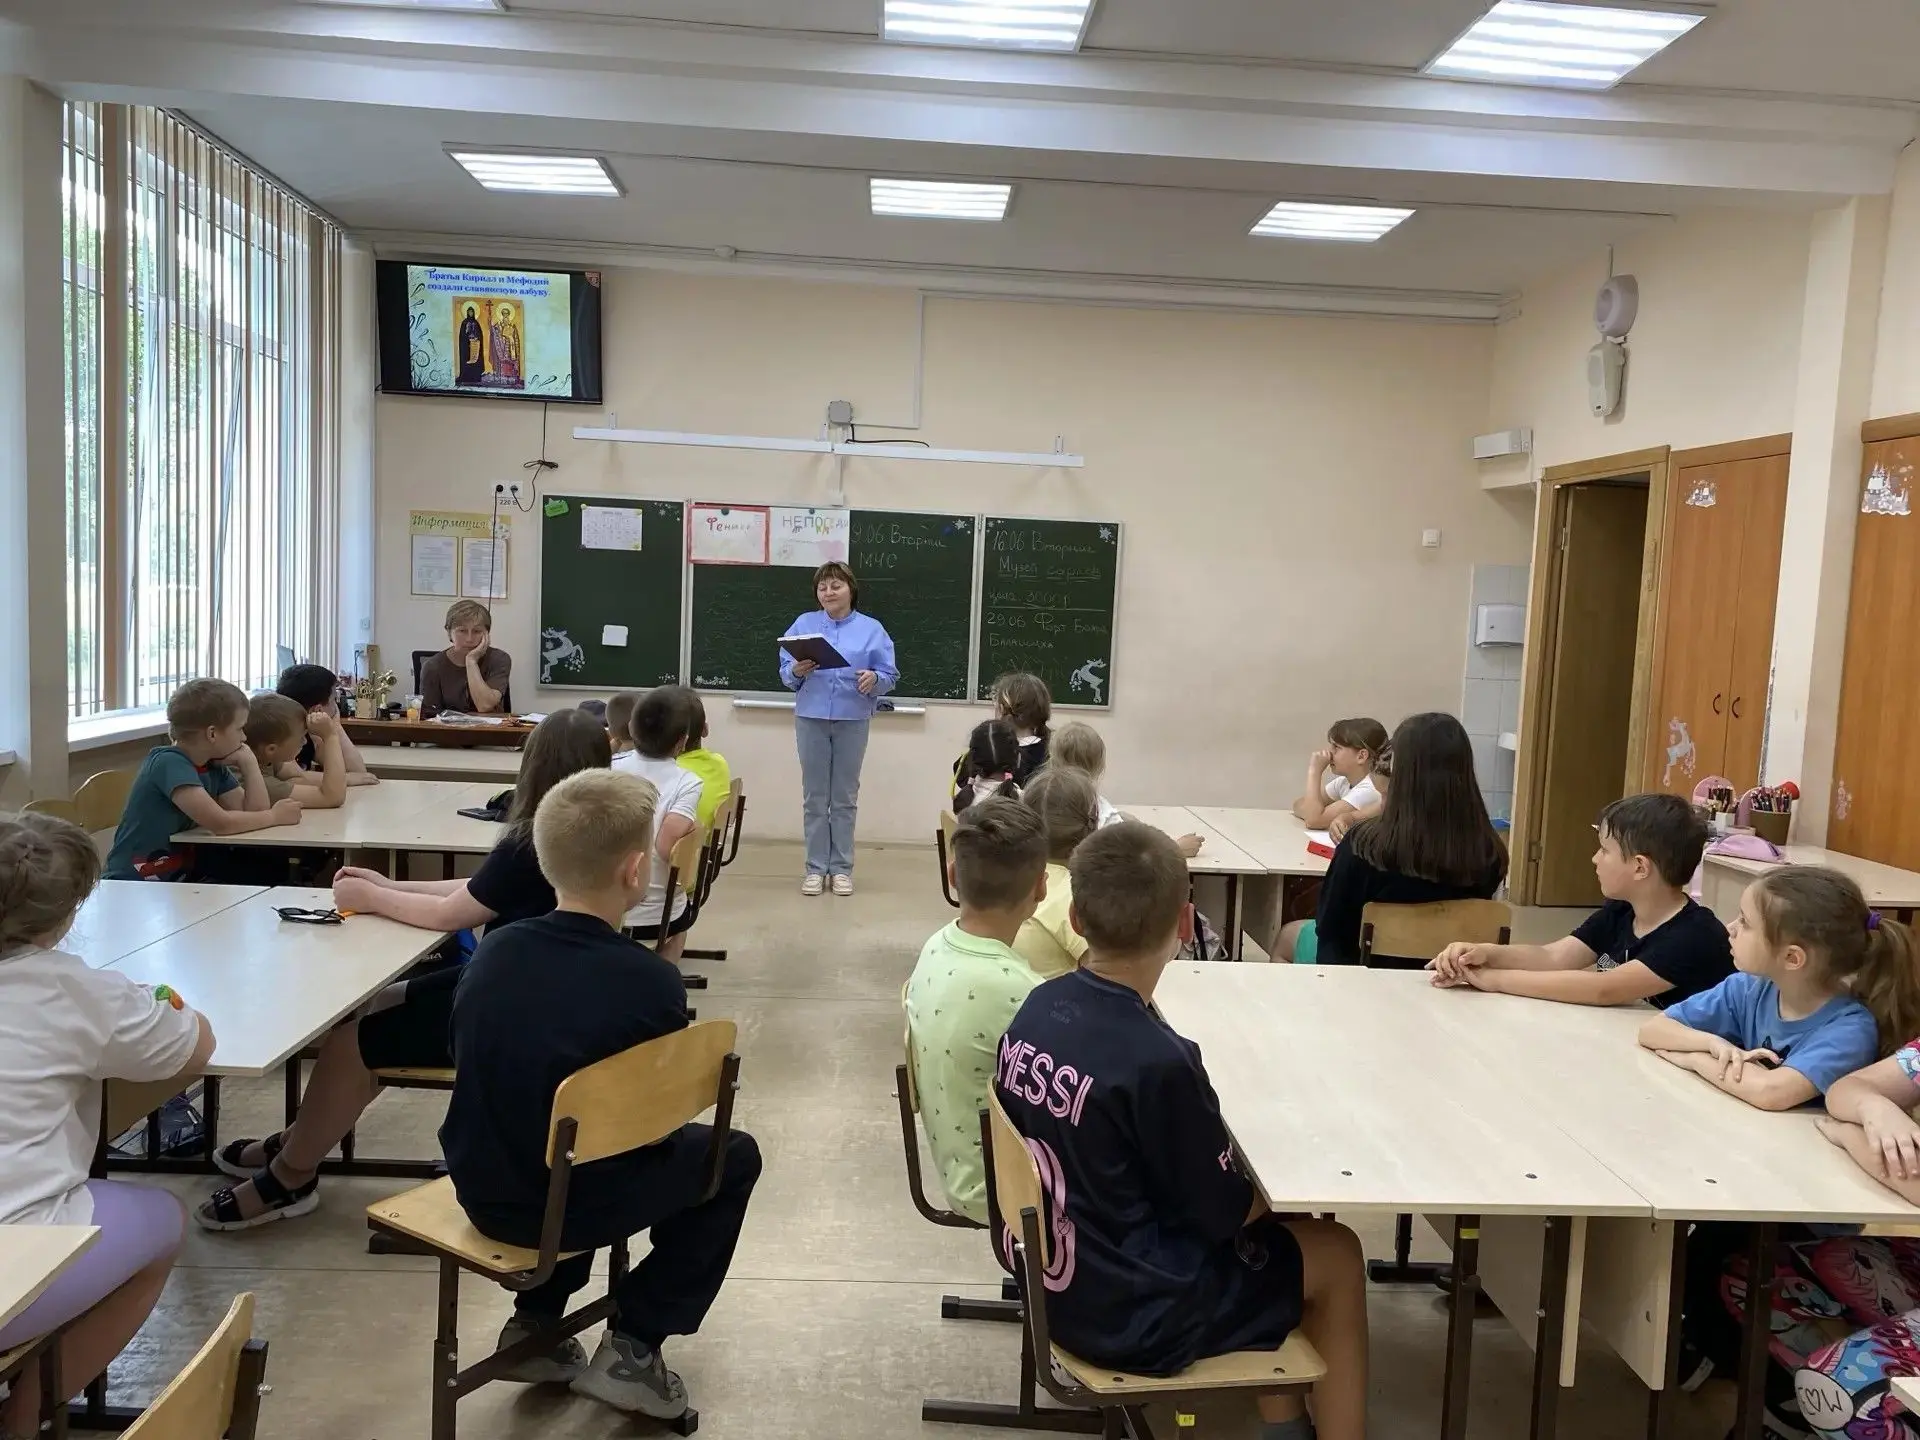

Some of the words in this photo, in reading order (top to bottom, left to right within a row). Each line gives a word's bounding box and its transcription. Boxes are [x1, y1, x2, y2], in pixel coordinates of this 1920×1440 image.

[429, 270, 460, 281] Братья
[462, 273, 497, 284] Кирилл
[506, 276, 549, 286] Мефодий
[427, 283, 463, 291] создали
[464, 285, 518, 295] славянскую
[411, 515, 487, 530] Информация
[997, 1033, 1095, 1127] MESSI
